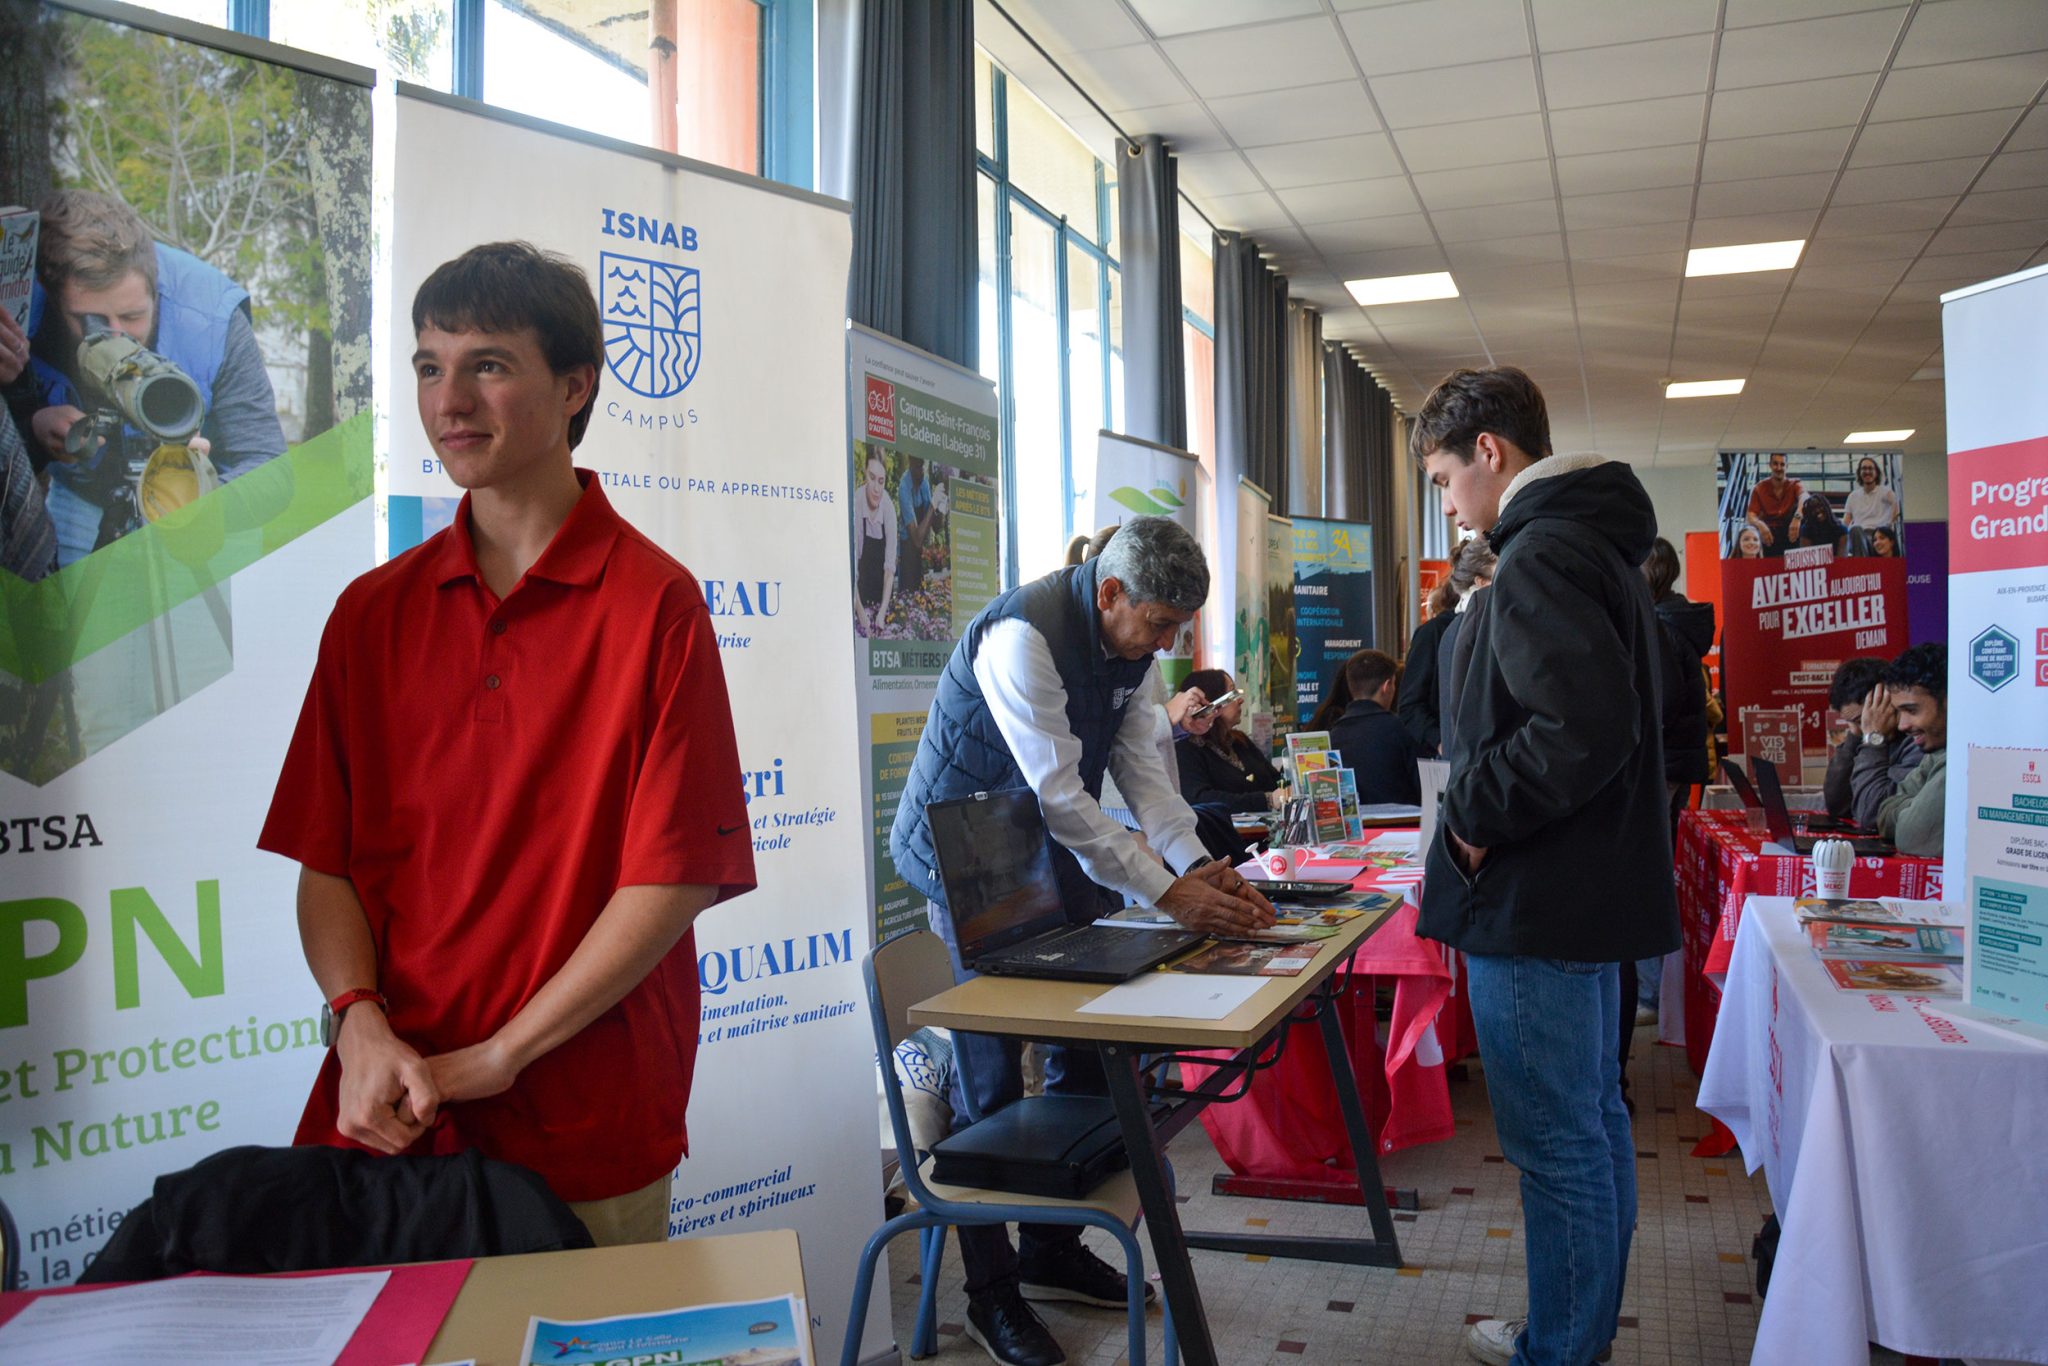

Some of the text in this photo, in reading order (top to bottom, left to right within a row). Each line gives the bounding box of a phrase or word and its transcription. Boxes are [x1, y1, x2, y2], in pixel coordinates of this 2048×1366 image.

[602, 208, 699, 252] ISNAB
[607, 401, 699, 432] CAMPUS
[869, 423, 894, 437] D'AUTEUIL
[900, 397, 934, 423] Campus
[935, 408, 991, 441] Saint-François
[900, 419, 986, 462] la Cadène (Labège 31)
[597, 471, 651, 489] TIALE
[658, 476, 681, 491] OU
[688, 479, 716, 494] PAR
[721, 481, 835, 504] APPRENTISSAGE
[1971, 505, 2048, 540] Grand
[1784, 545, 1834, 570] CHOISIS TON
[1752, 568, 1881, 609] AVENIR AUJOURD'HUI
[1907, 573, 1931, 584] OUSE
[1997, 583, 2046, 595] AIX-EN-PROVENCE
[699, 579, 782, 617] EAU
[1300, 605, 1340, 616] COOPÉRATION
[1296, 617, 1345, 628] INTERNATIONALE
[1759, 594, 1886, 640] POUR EXCELLER
[1324, 639, 1361, 648] MANAGEMENT
[1855, 629, 1887, 650] DEMAIN
[873, 650, 901, 668] BTSA
[901, 648, 941, 668] MÉTIERS
[1311, 682, 1319, 691] ET
[1793, 673, 1824, 682] POST-BAC
[1761, 737, 1784, 747] VIS
[1762, 752, 1784, 762] VIE
[2022, 773, 2041, 784] ESSCA
[1980, 808, 1988, 818] EN
[1989, 809, 2034, 824] MANAGEMENT
[2015, 796, 2048, 809] BACHELOR
[753, 807, 836, 829] et Stratégie
[2025, 849, 2033, 858] DE
[698, 928, 853, 995] QUALIM
[702, 993, 788, 1022] imentation.
[708, 1000, 856, 1044] et maîtrise sanitaire
[53, 1016, 320, 1092] Protection
[31, 1100, 221, 1169] Nature
[671, 1165, 792, 1214] ico-commercial
[667, 1183, 816, 1238] bières et spiritueux
[30, 1207, 132, 1253] métie
[41, 1256, 72, 1285] la
